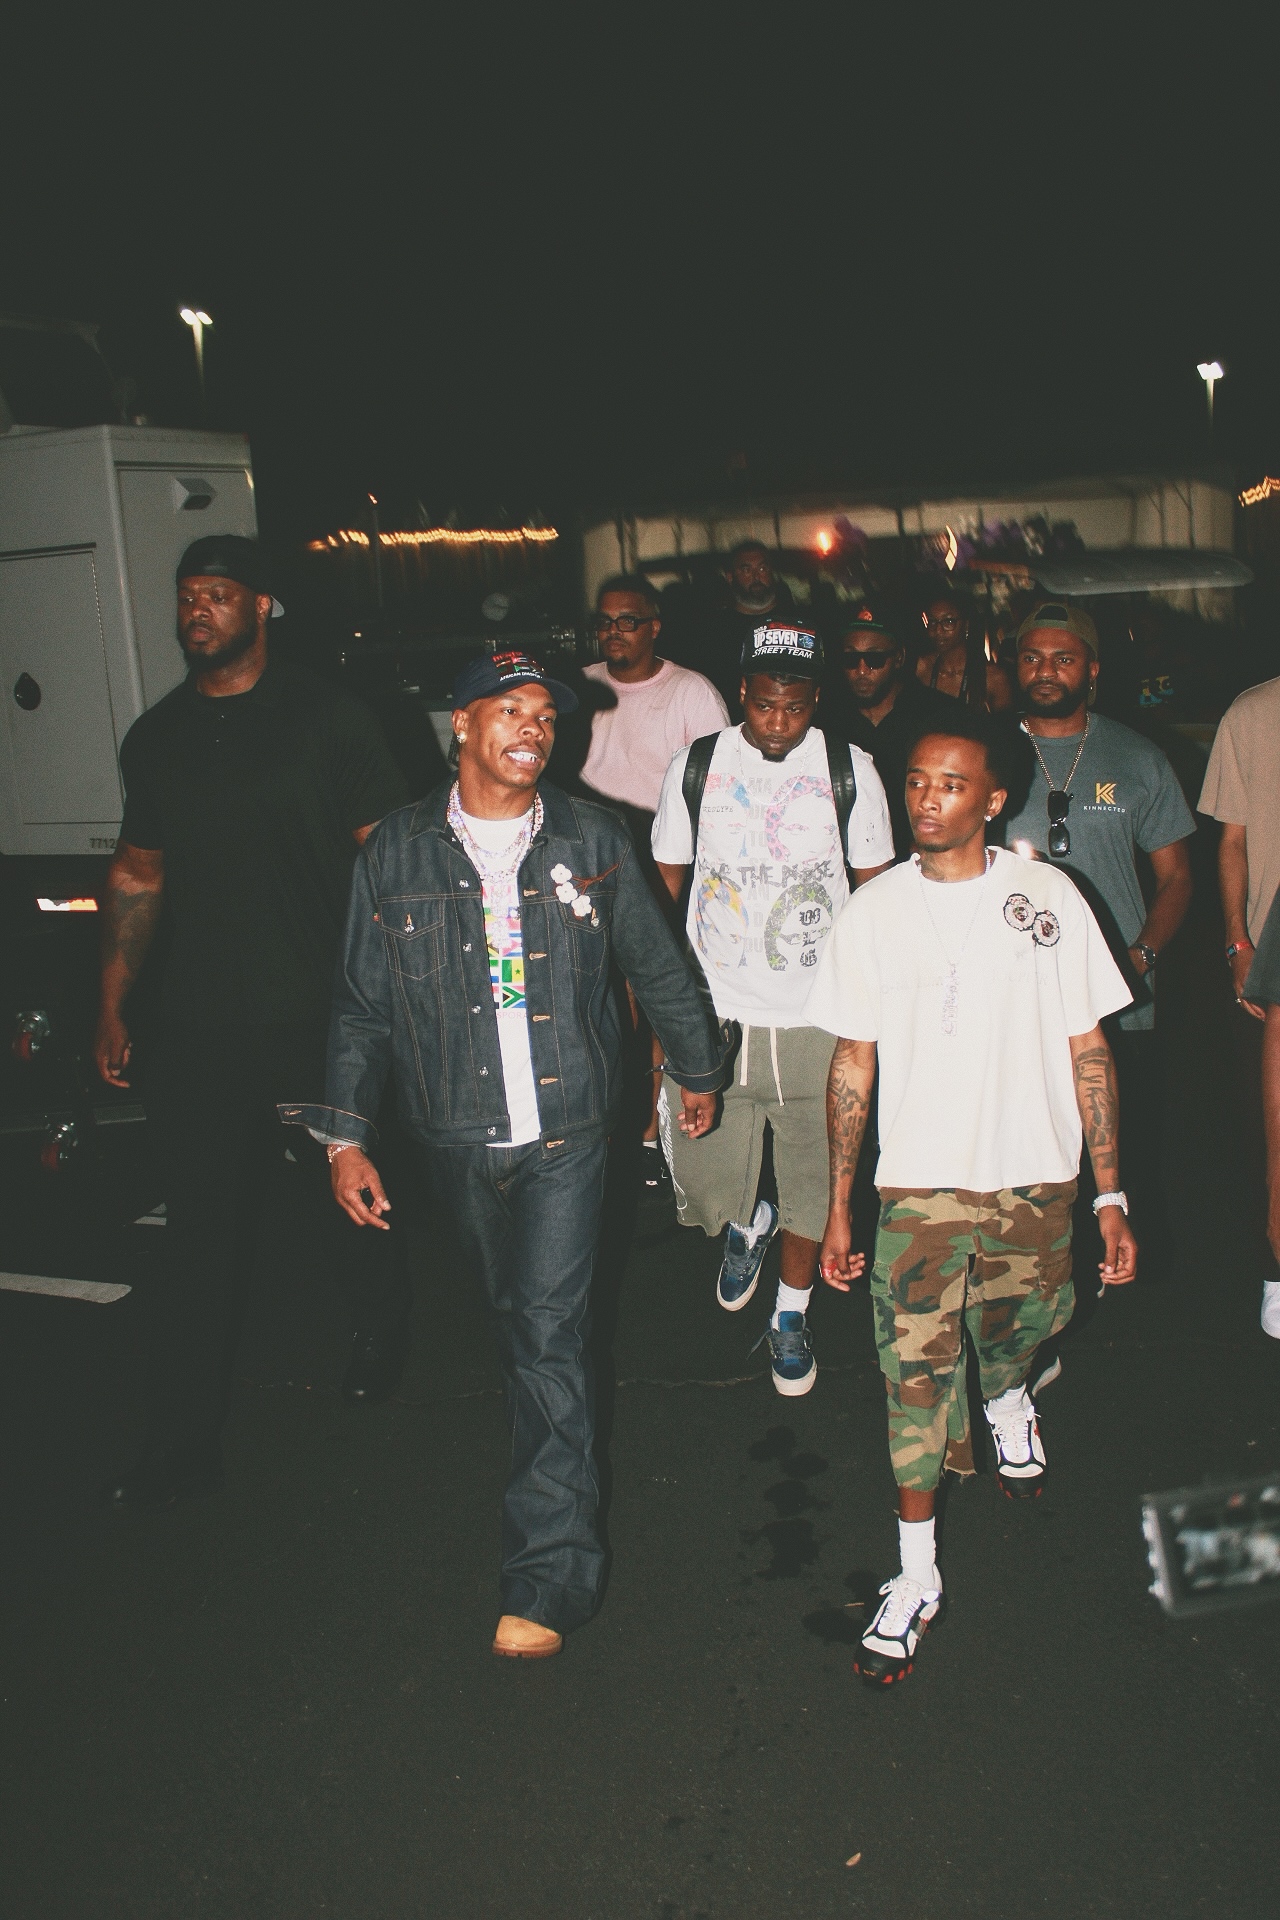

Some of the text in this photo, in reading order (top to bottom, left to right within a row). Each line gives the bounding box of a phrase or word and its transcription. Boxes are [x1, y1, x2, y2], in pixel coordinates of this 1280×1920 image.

[765, 630, 799, 647] SEVEN
[752, 647, 813, 660] STREET TEAM
[1083, 805, 1126, 813] KINNECTED
